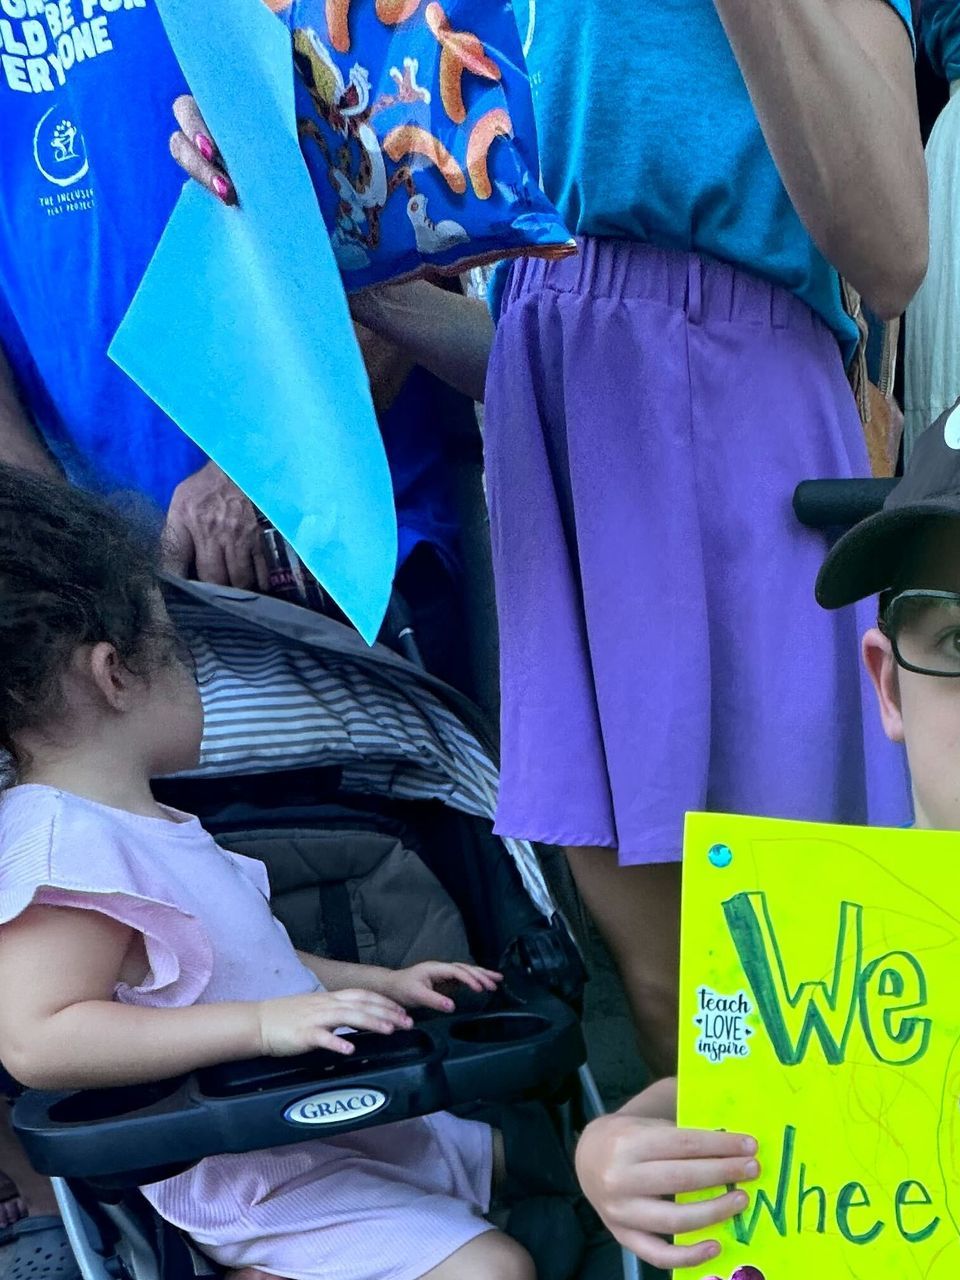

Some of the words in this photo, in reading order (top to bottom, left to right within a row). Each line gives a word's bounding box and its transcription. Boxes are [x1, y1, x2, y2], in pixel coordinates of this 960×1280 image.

[721, 891, 932, 1066] We
[698, 988, 751, 1013] teach
[705, 1014, 742, 1040] LOVE
[698, 1039, 748, 1061] inspire
[299, 1093, 377, 1119] GRACO
